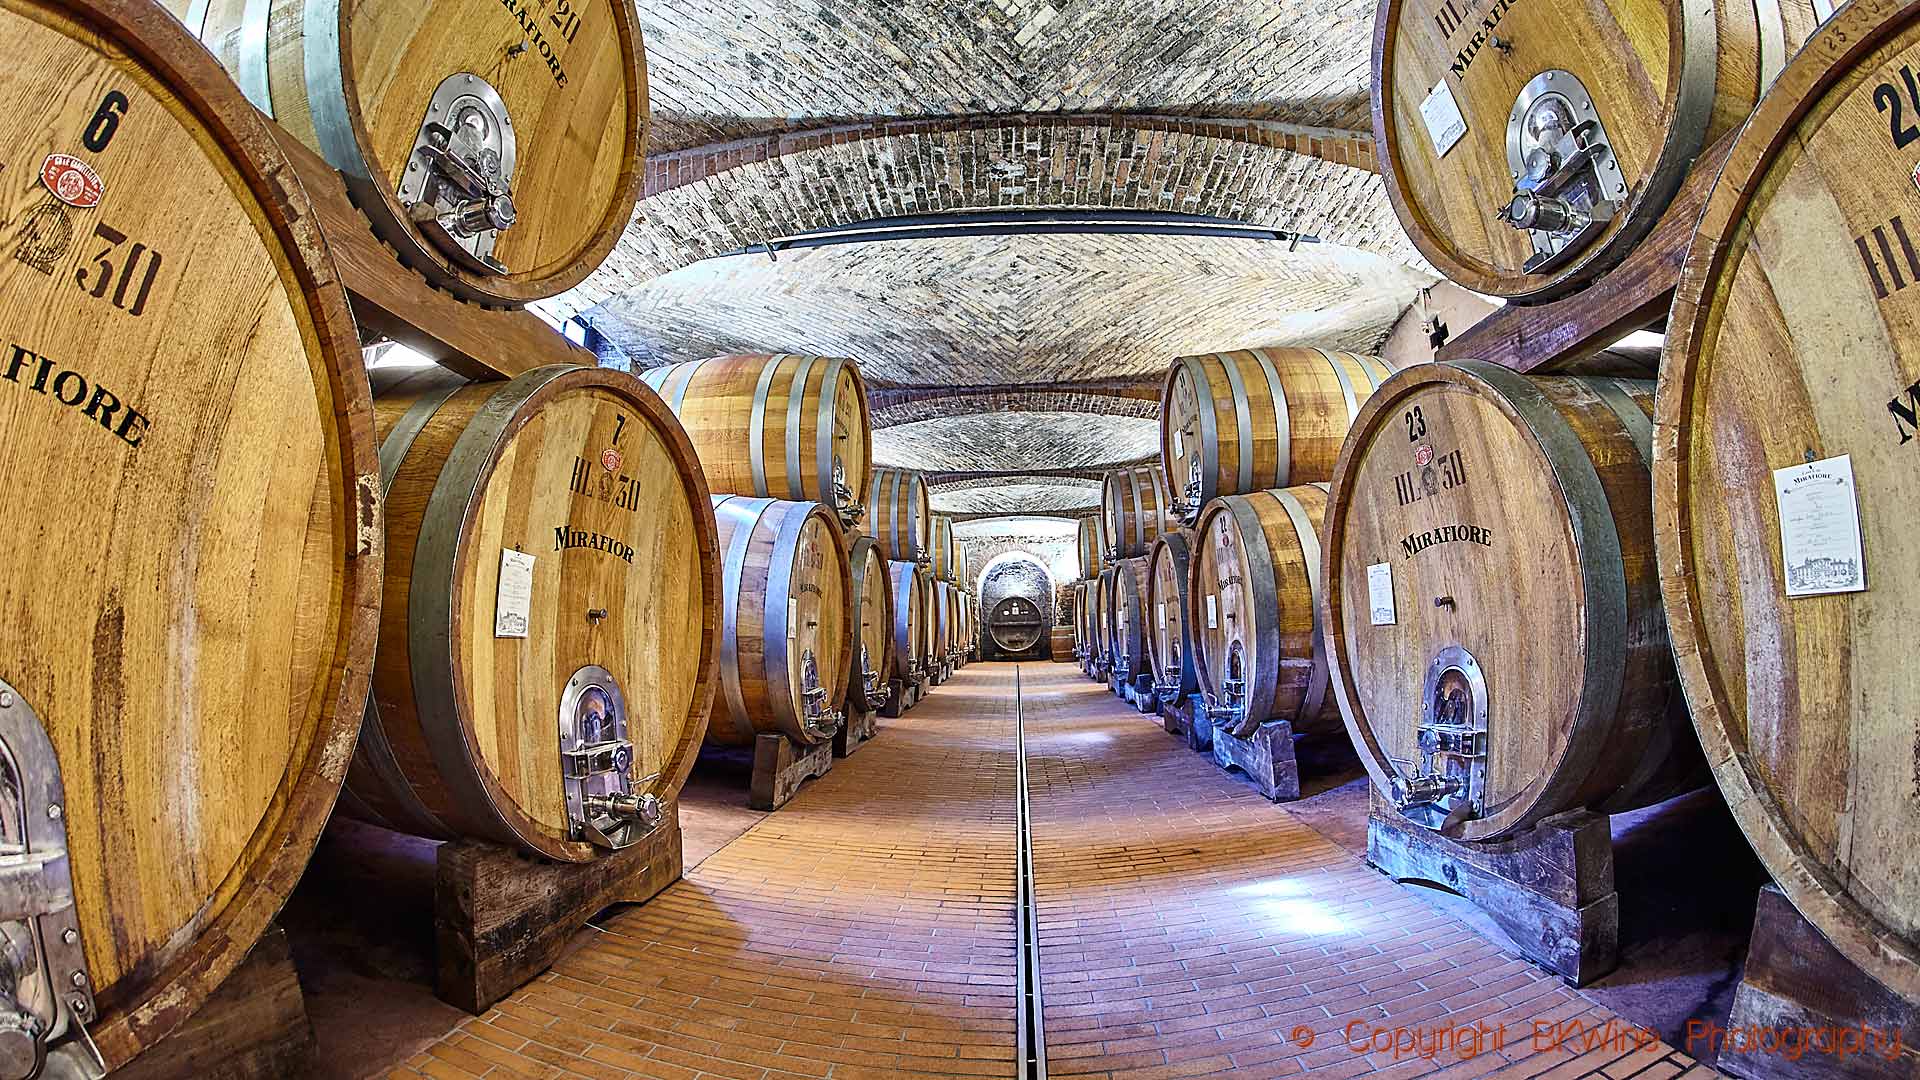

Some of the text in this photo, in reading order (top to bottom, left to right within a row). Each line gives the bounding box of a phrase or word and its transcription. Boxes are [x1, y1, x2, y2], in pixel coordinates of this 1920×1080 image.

[1450, 0, 1518, 82] MIRAFI
[83, 90, 129, 153] 6
[76, 221, 162, 316] 30
[0, 338, 150, 448] FIORE
[612, 413, 626, 446] 7
[1405, 405, 1426, 442] 23
[1437, 449, 1466, 490] 30
[616, 473, 641, 512] 30
[1400, 524, 1492, 560] MIRAFIORE
